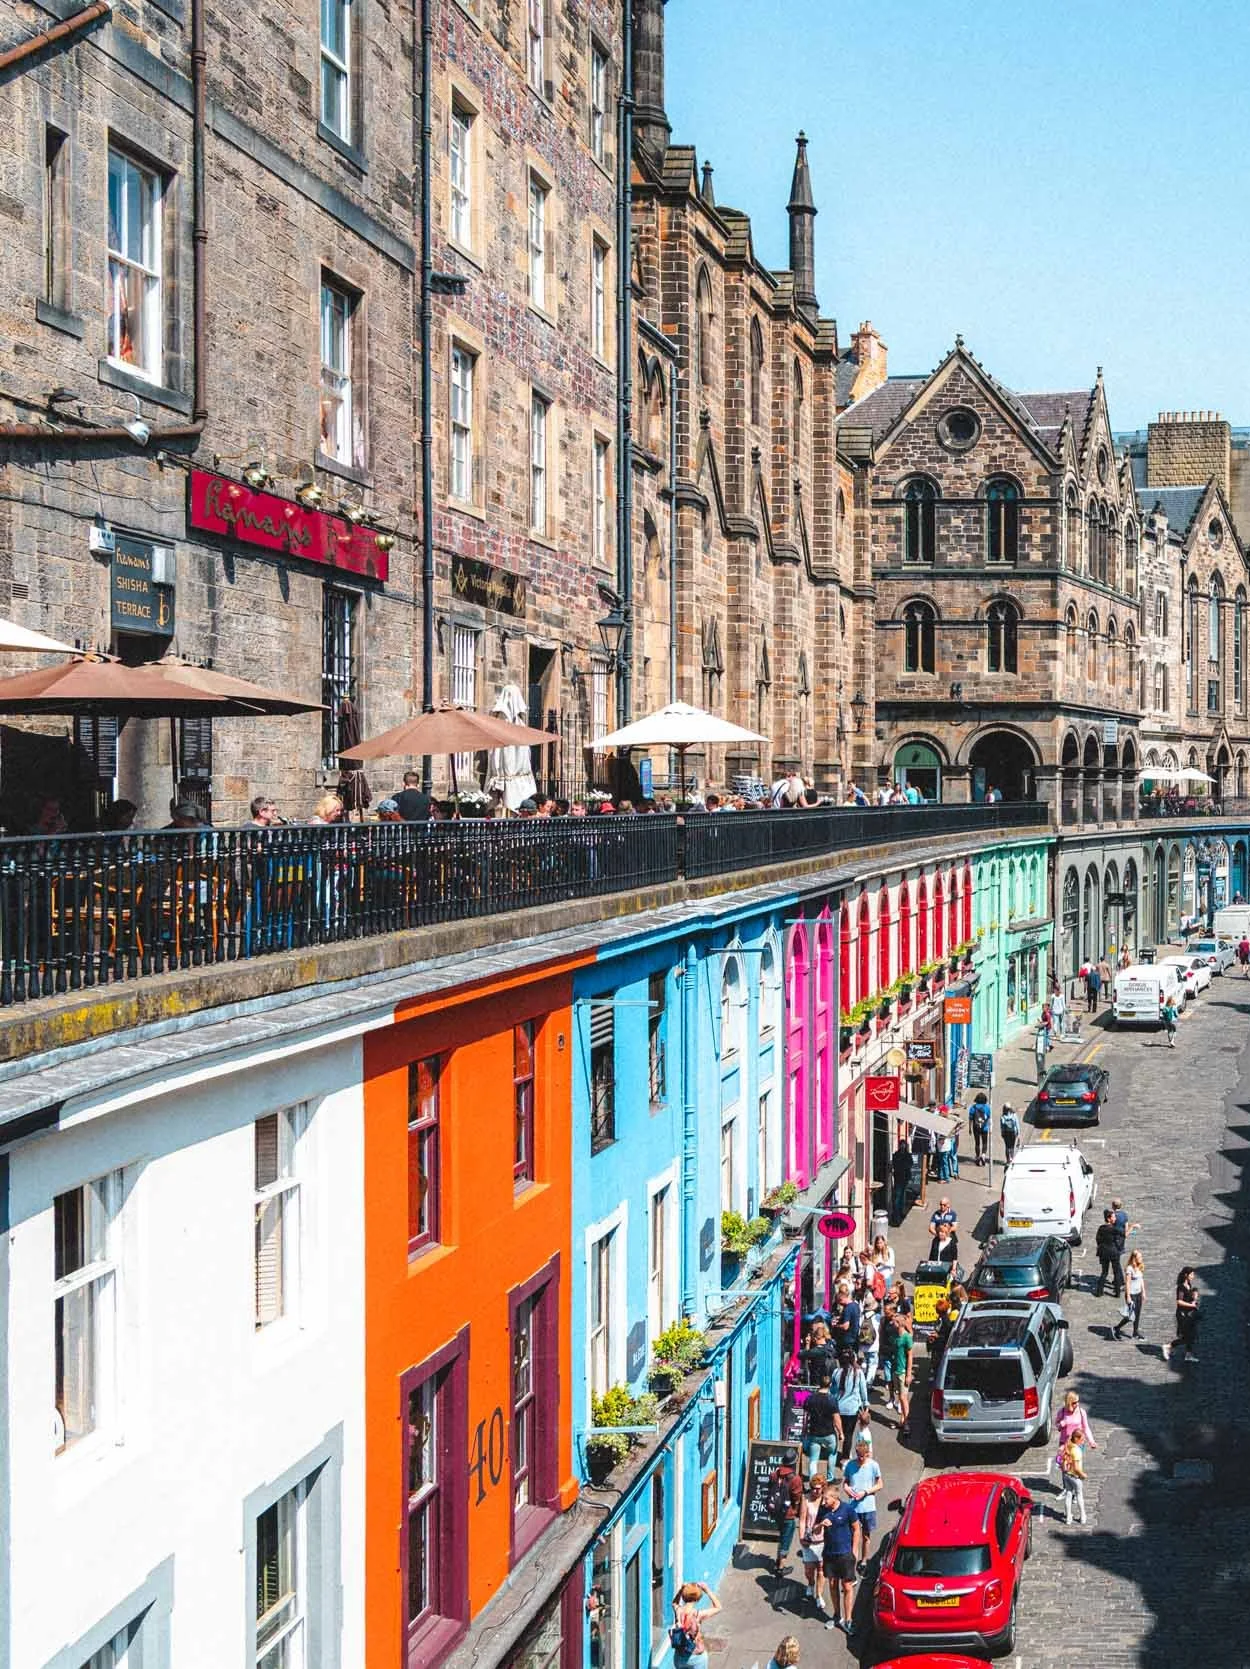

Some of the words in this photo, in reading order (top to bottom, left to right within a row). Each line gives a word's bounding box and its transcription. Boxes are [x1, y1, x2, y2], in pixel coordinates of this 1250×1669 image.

[116, 576, 148, 593] SHISHA
[115, 600, 151, 618] TERRACE
[465, 1406, 504, 1507] 40
[754, 1466, 780, 1475] LUN
